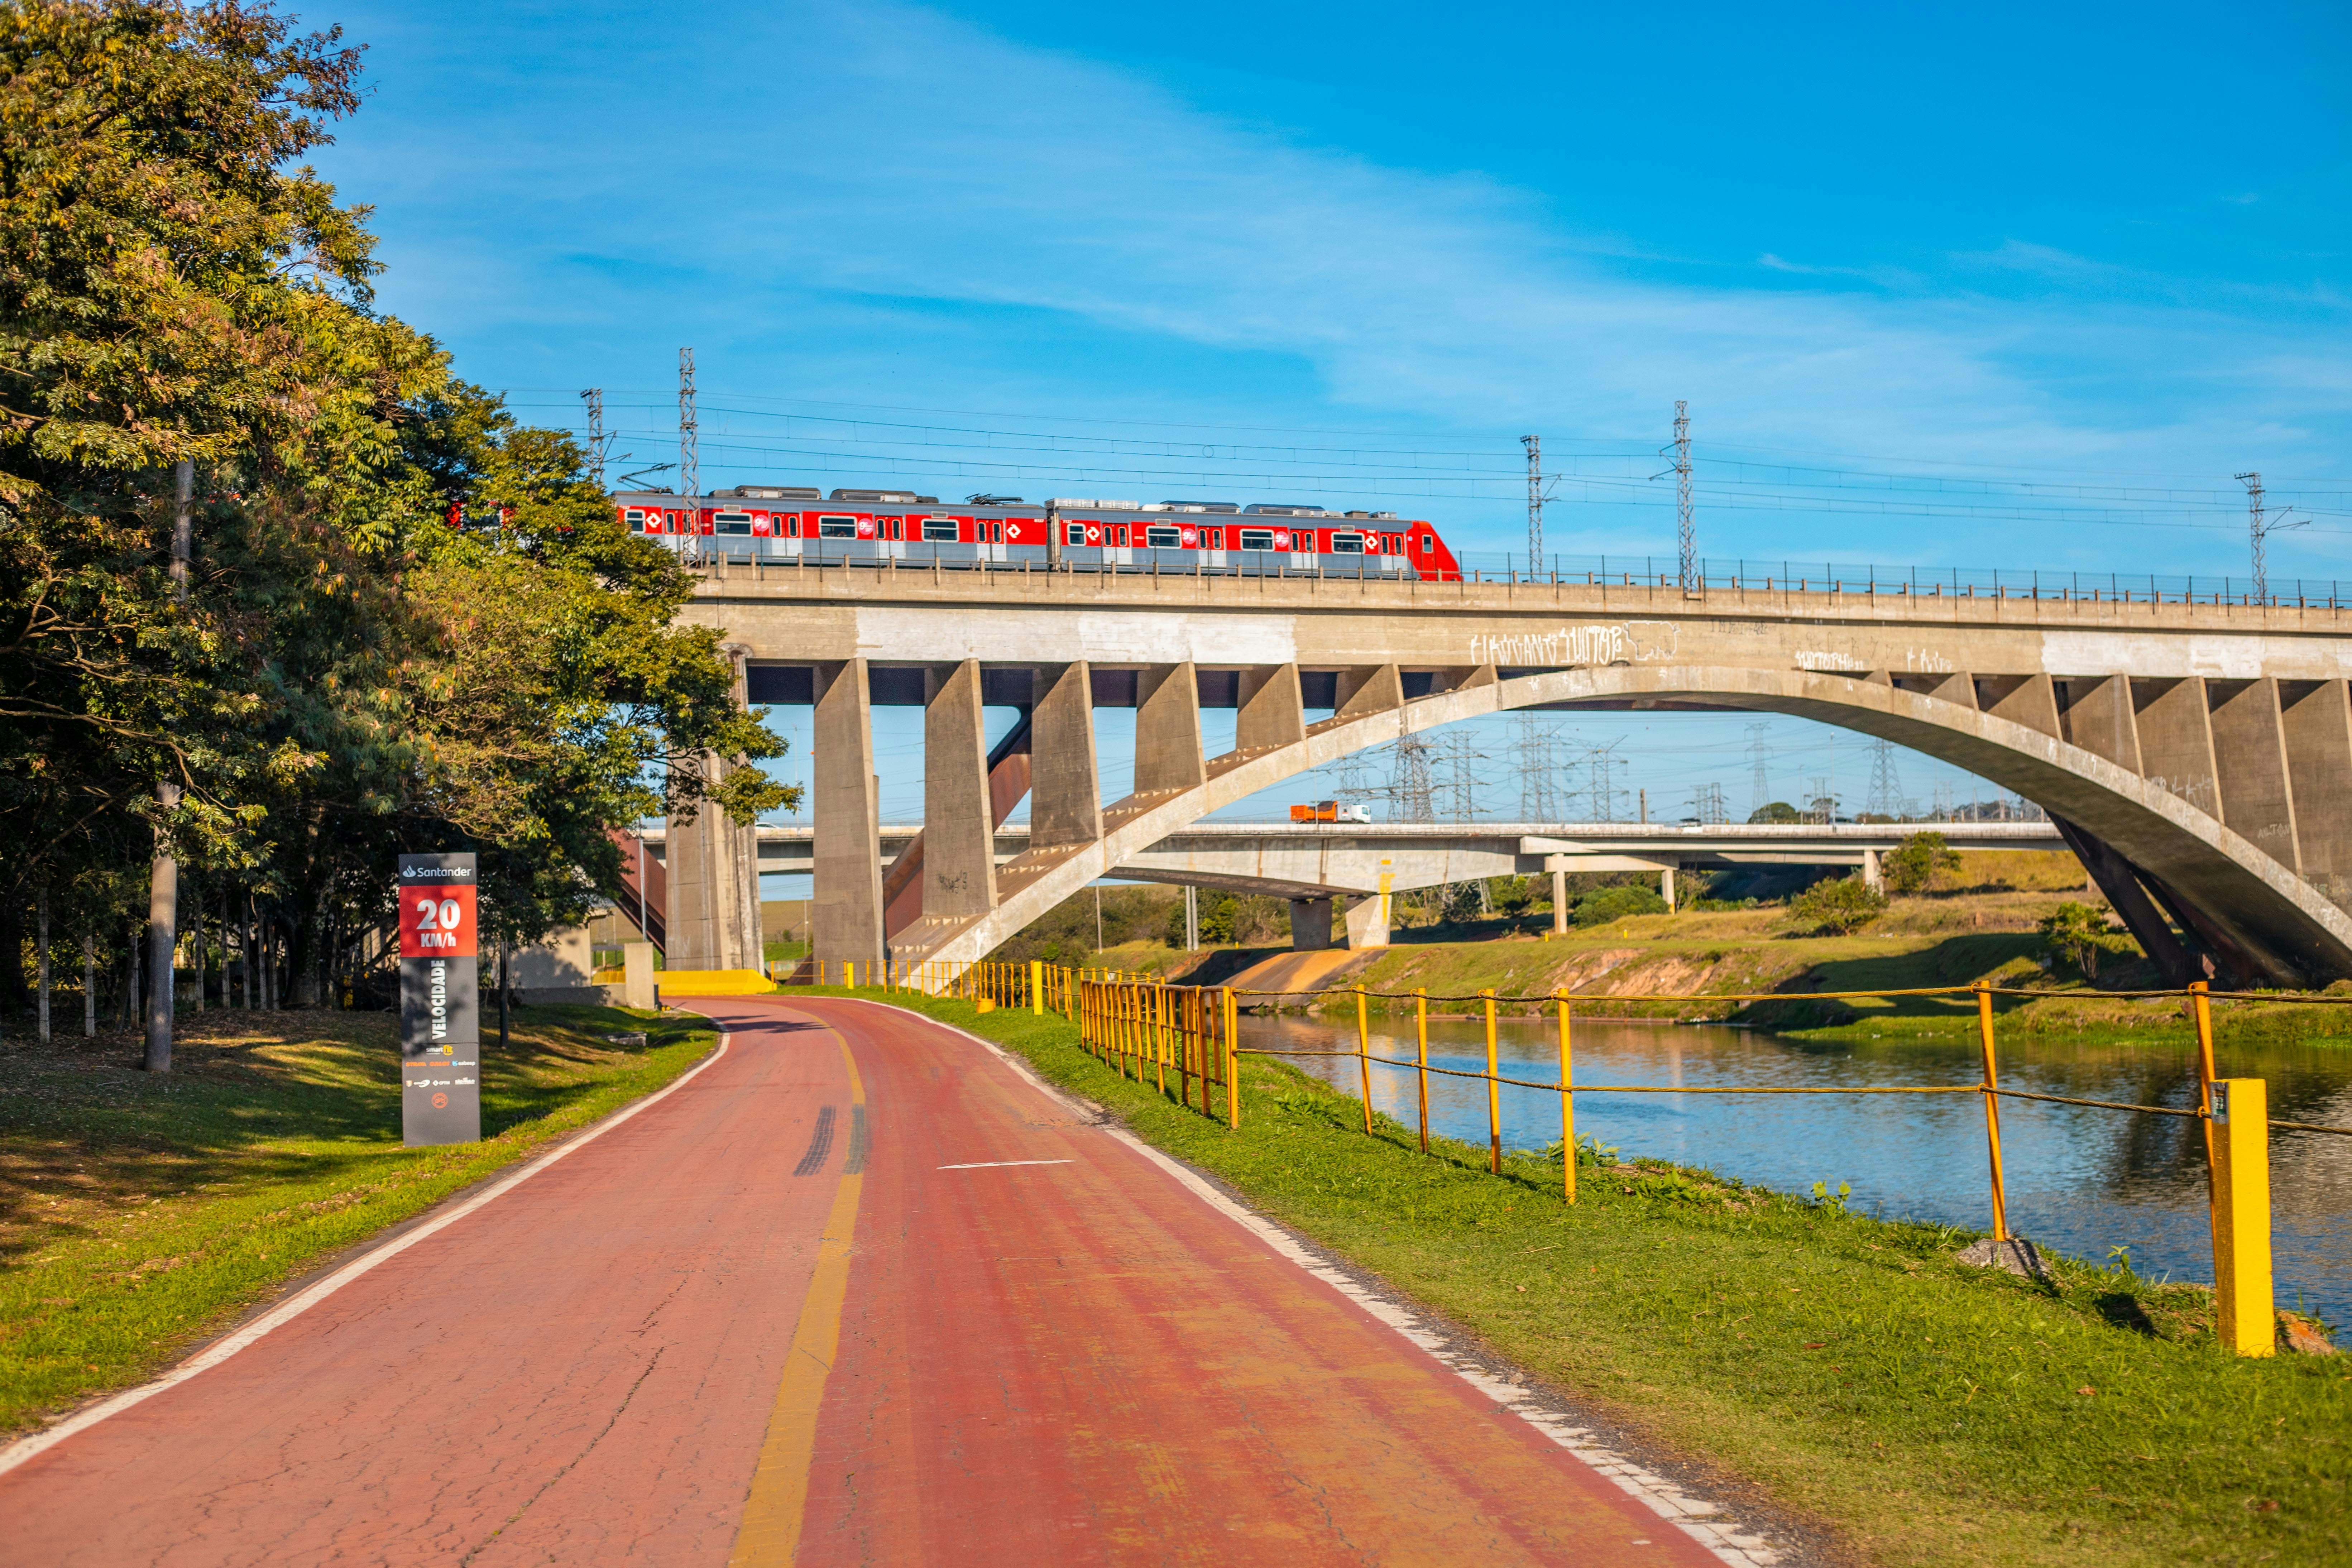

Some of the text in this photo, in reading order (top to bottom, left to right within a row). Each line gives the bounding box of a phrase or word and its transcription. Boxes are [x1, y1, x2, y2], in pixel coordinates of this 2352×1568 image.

[417, 867, 472, 877] Santander
[416, 899, 461, 930] 20
[421, 932, 456, 948] KM/h
[431, 960, 446, 1040] VELOCIDADE
